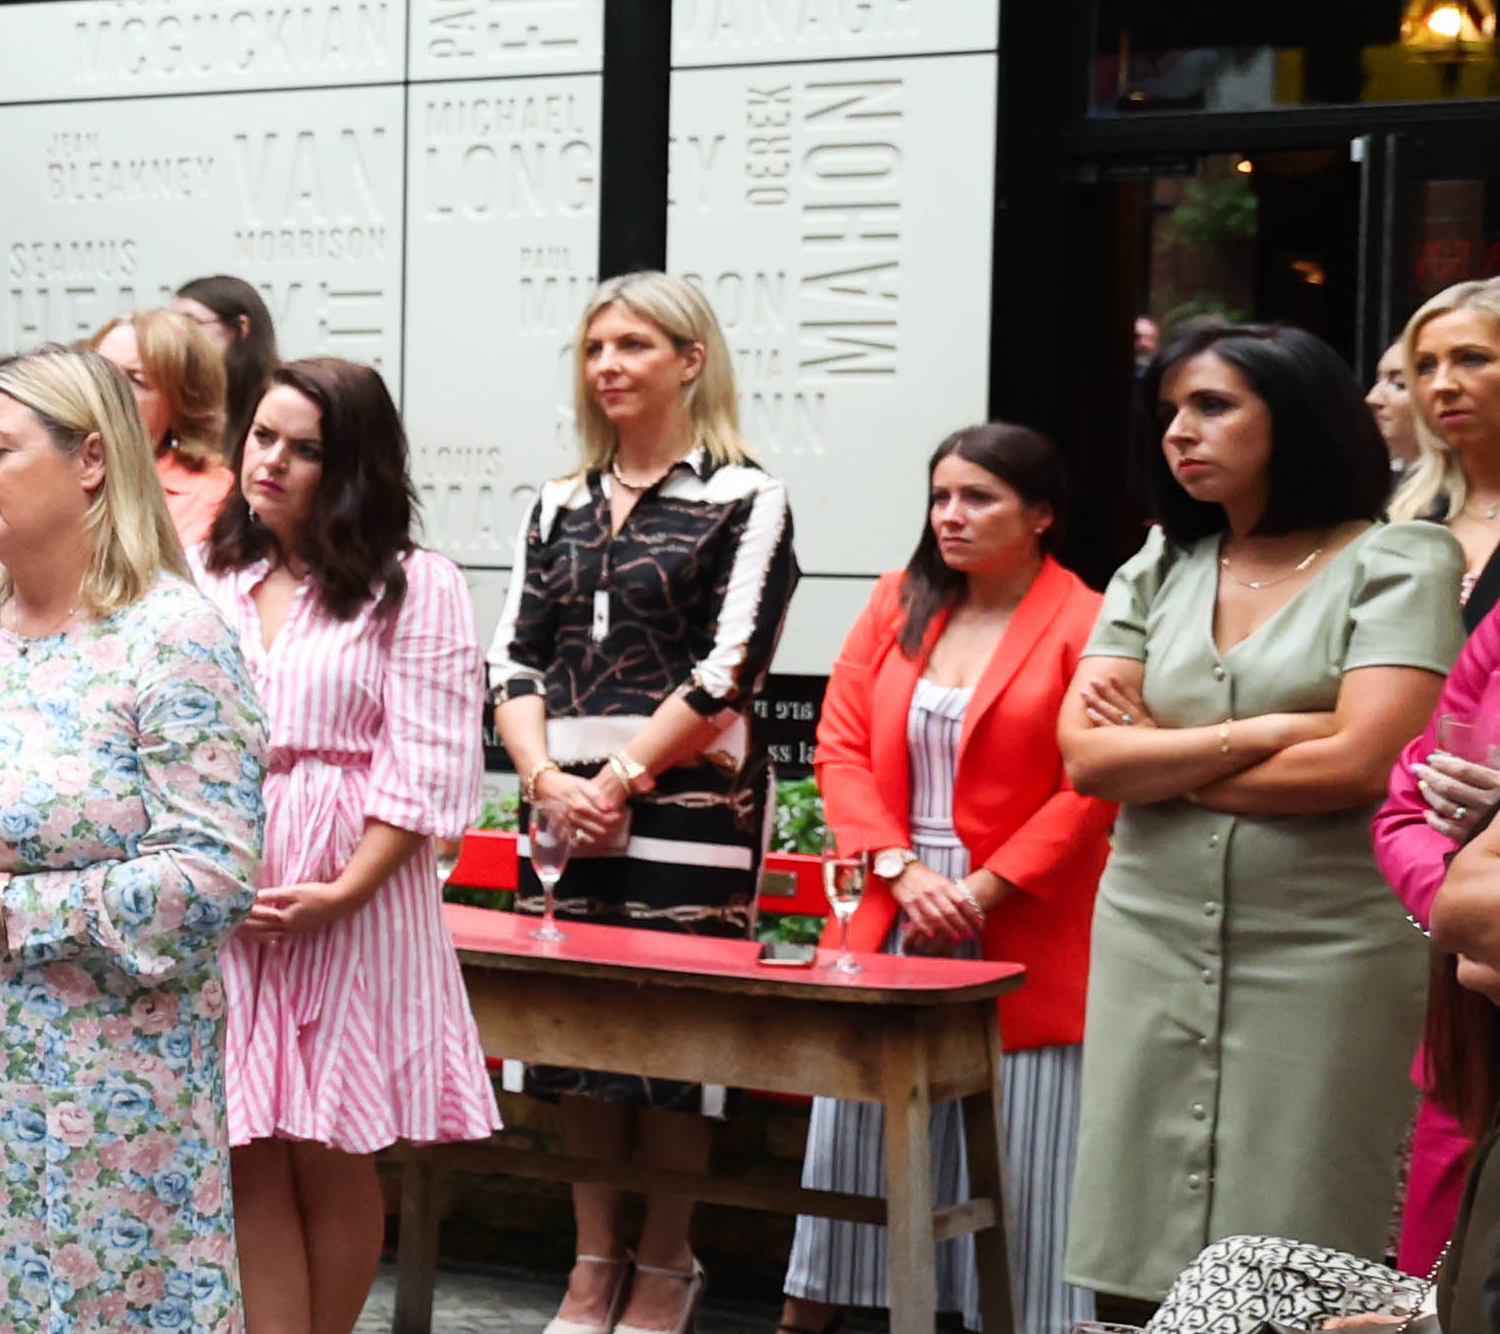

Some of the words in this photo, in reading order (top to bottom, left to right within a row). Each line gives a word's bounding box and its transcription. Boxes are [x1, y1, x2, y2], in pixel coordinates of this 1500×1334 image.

[424, 92, 584, 140] MICHAEL
[230, 123, 390, 224] VAN
[744, 82, 794, 212] DEREK
[44, 155, 219, 208] BLEAKNEY
[423, 132, 729, 223] LONGY
[232, 224, 388, 267] MORRISON
[518, 244, 572, 269] PAUL
[797, 76, 906, 384] MAHON
[7, 237, 140, 284] SEAMUS
